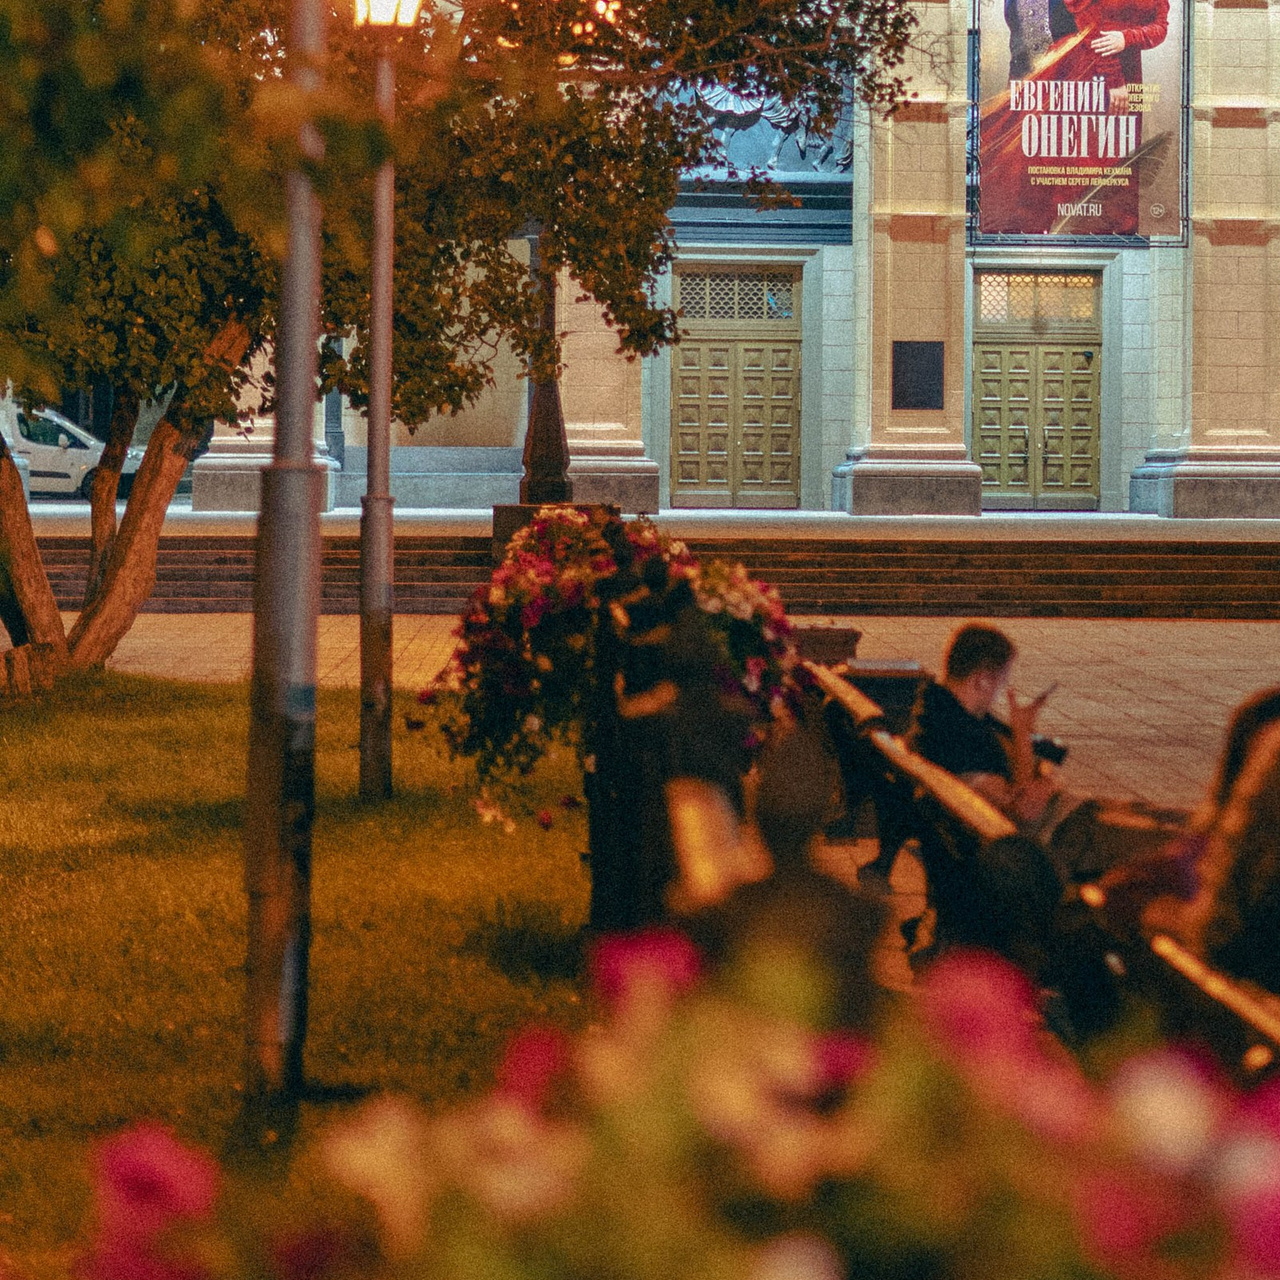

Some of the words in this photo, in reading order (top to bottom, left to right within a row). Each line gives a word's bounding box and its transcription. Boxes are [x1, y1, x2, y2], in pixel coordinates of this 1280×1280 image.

[1009, 76, 1106, 113] ЕВГЕНИЙ
[1021, 113, 1138, 158] ОНЕГИН
[1027, 166, 1066, 175] ПОСТАНОВКА
[1066, 166, 1103, 176] ВЛАДИМИРА
[1030, 177, 1036, 186] С
[1036, 177, 1068, 186] УЧАСТИЕМ
[1068, 177, 1090, 186] СЕРГЕЯ
[1057, 203, 1102, 217] NOVAT.RU
